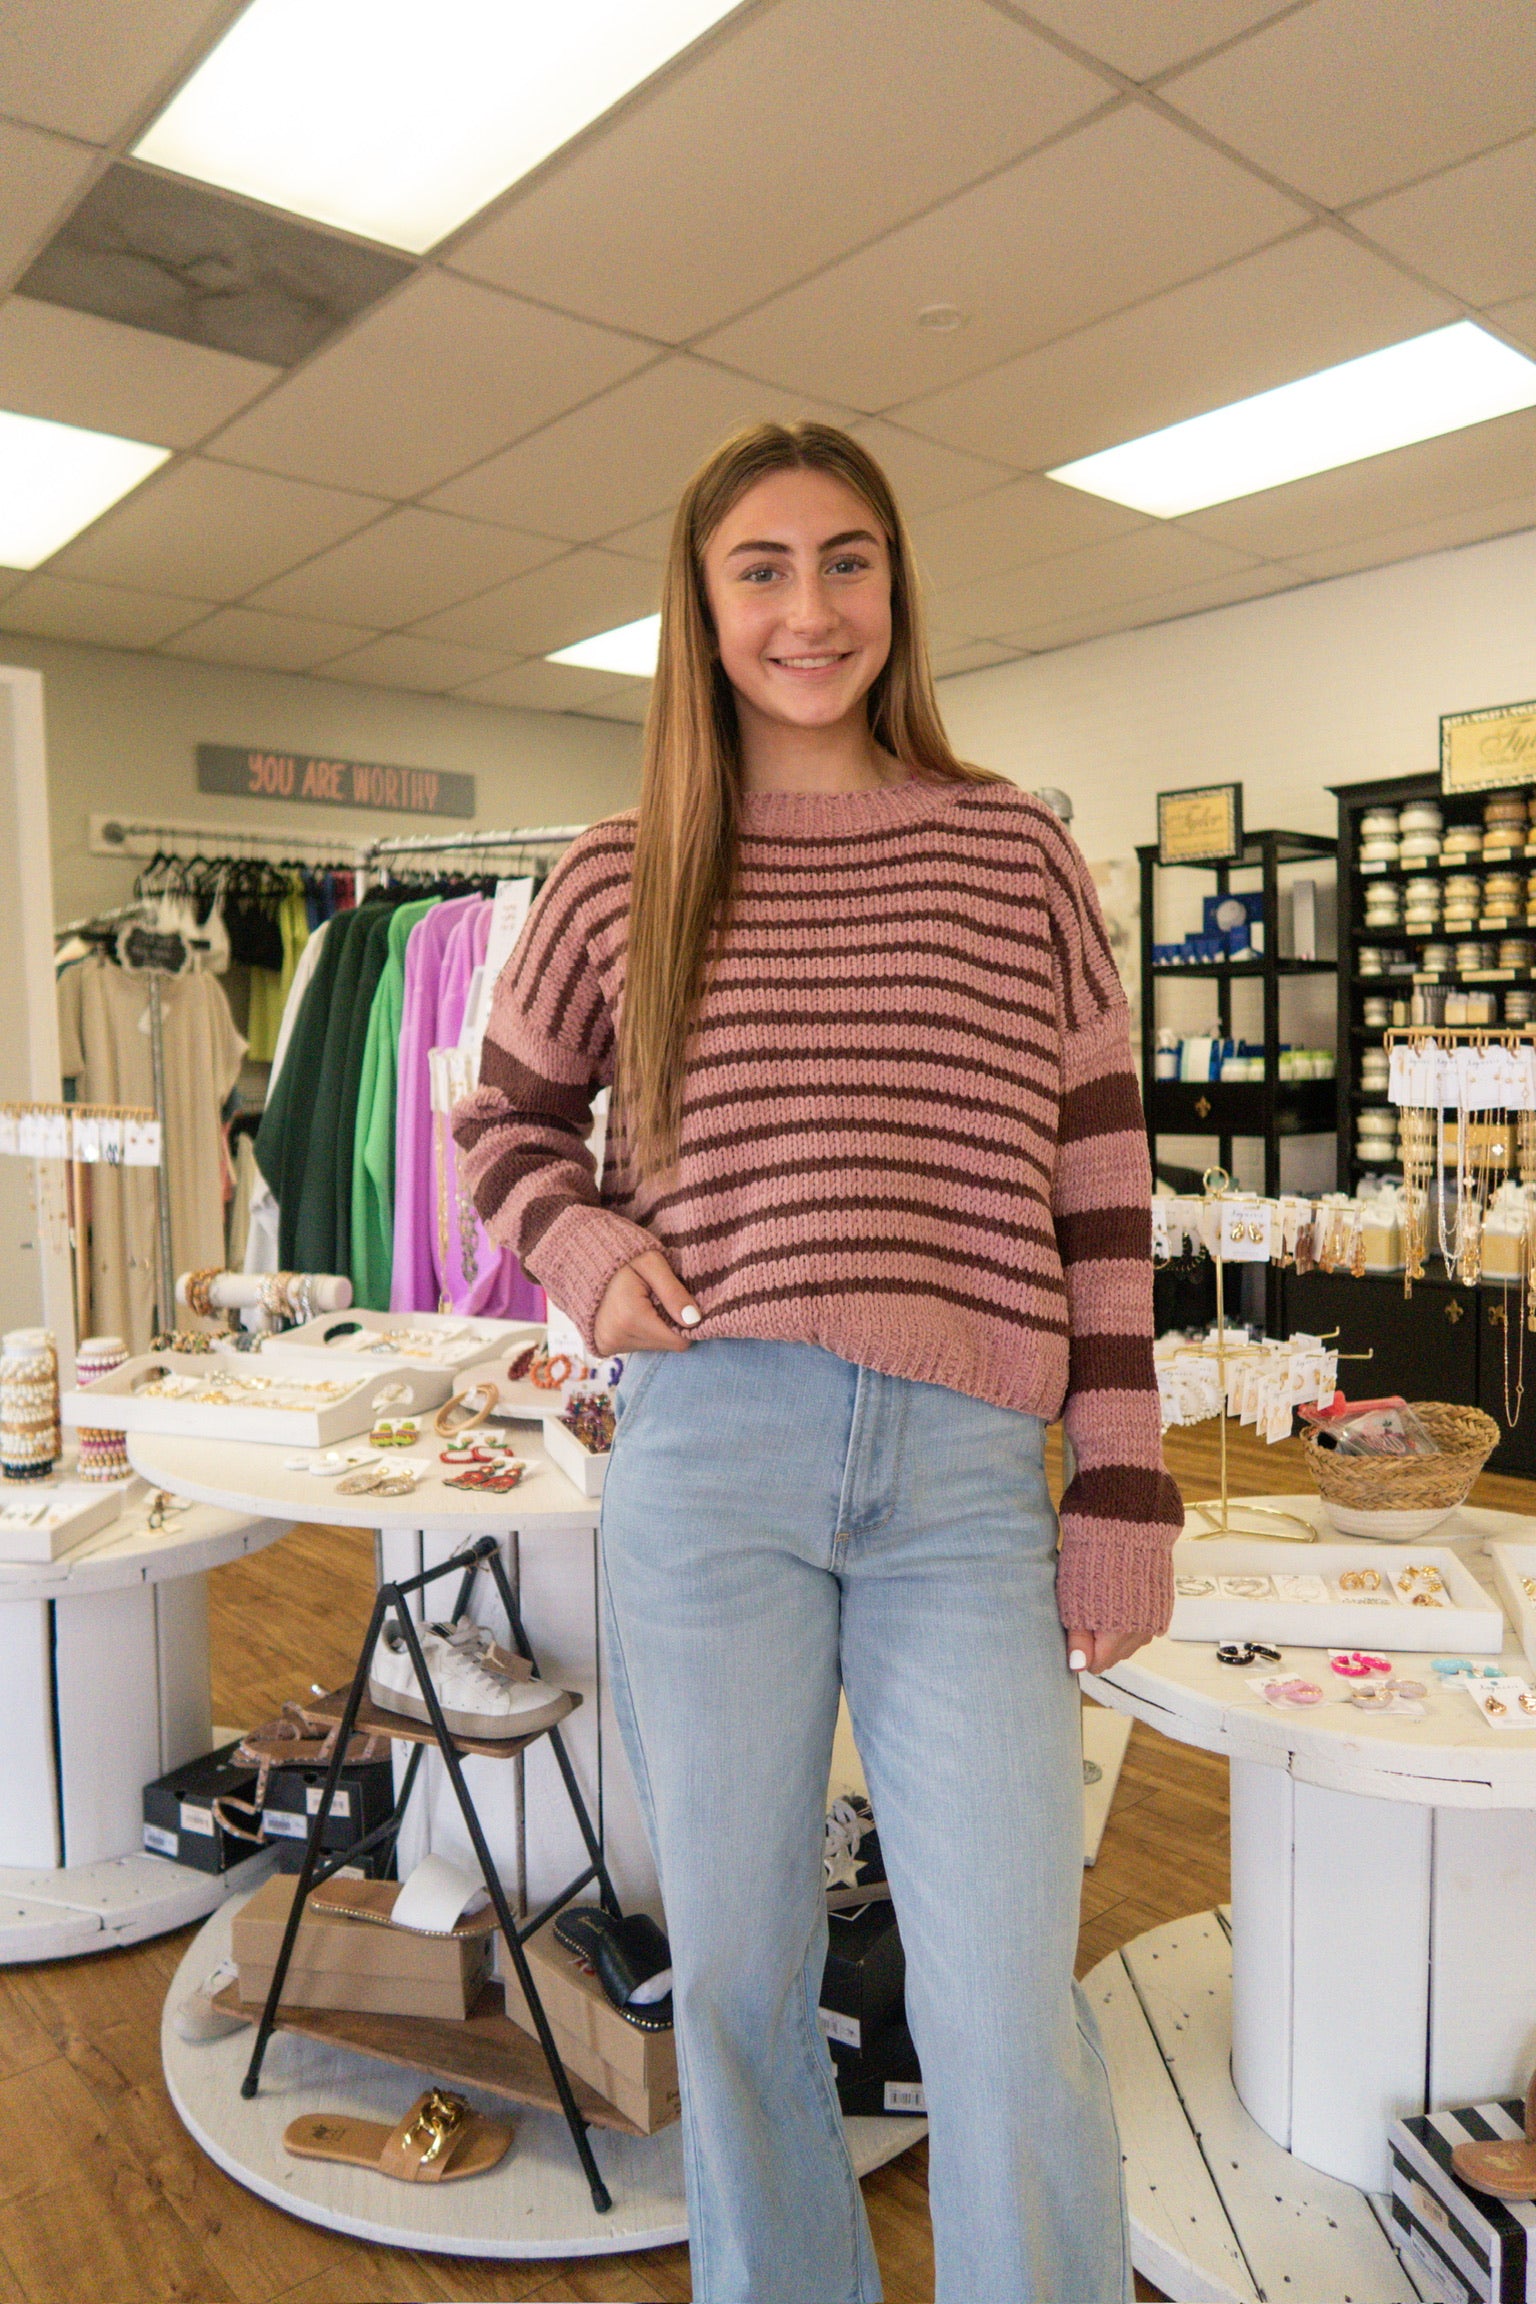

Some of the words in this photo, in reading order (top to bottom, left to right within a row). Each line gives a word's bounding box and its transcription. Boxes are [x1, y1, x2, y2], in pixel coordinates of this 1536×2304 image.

[247, 752, 295, 796] YOU
[300, 759, 347, 801] ARE
[352, 764, 440, 811] WORTHY
